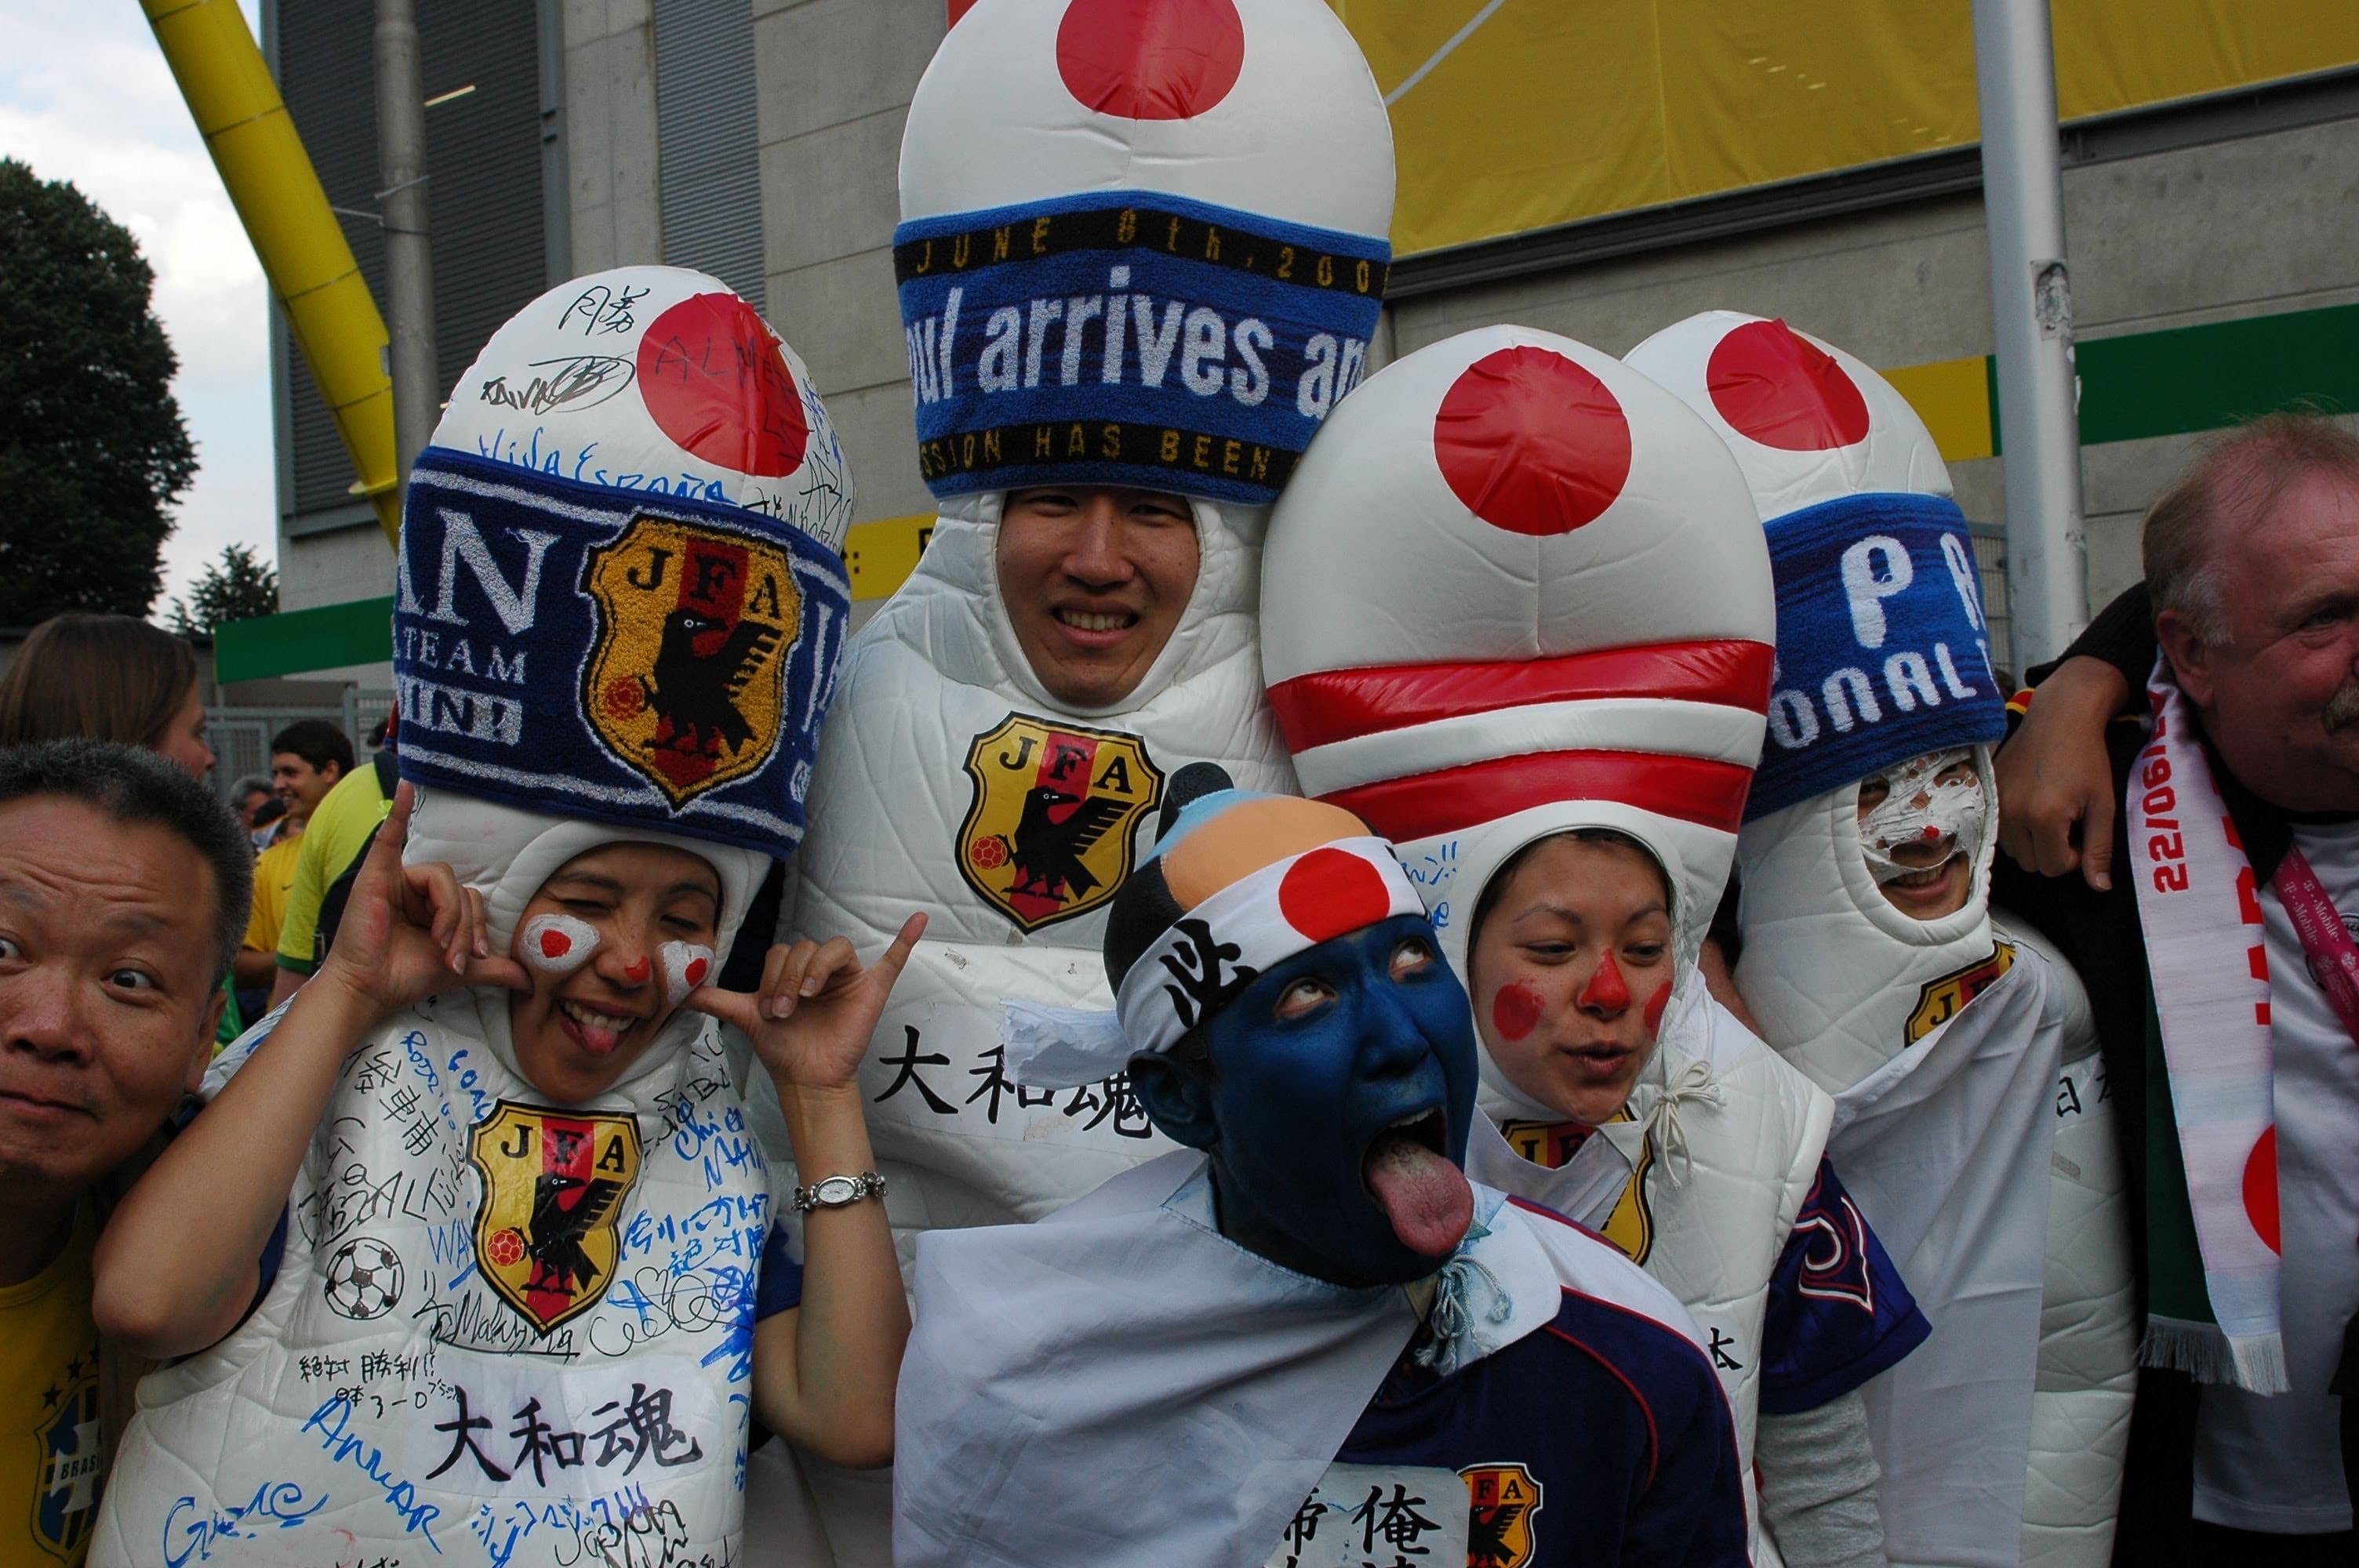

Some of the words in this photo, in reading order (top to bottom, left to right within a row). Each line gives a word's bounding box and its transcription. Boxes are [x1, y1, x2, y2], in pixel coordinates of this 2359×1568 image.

[916, 216, 1049, 274] JUNE
[1117, 209, 1388, 296] 8th,200
[977, 264, 1274, 407] arrives
[1034, 423, 1121, 460] HAS
[1159, 430, 1270, 481] BEEN
[402, 626, 528, 685] TEAM
[999, 735, 1134, 795] JFA
[500, 1121, 628, 1174] JFA
[426, 1383, 703, 1488] 大和魂
[60, 1452, 102, 1481] BRASI
[1466, 1478, 1525, 1500] FA
[1351, 1483, 1442, 1567] 俺
